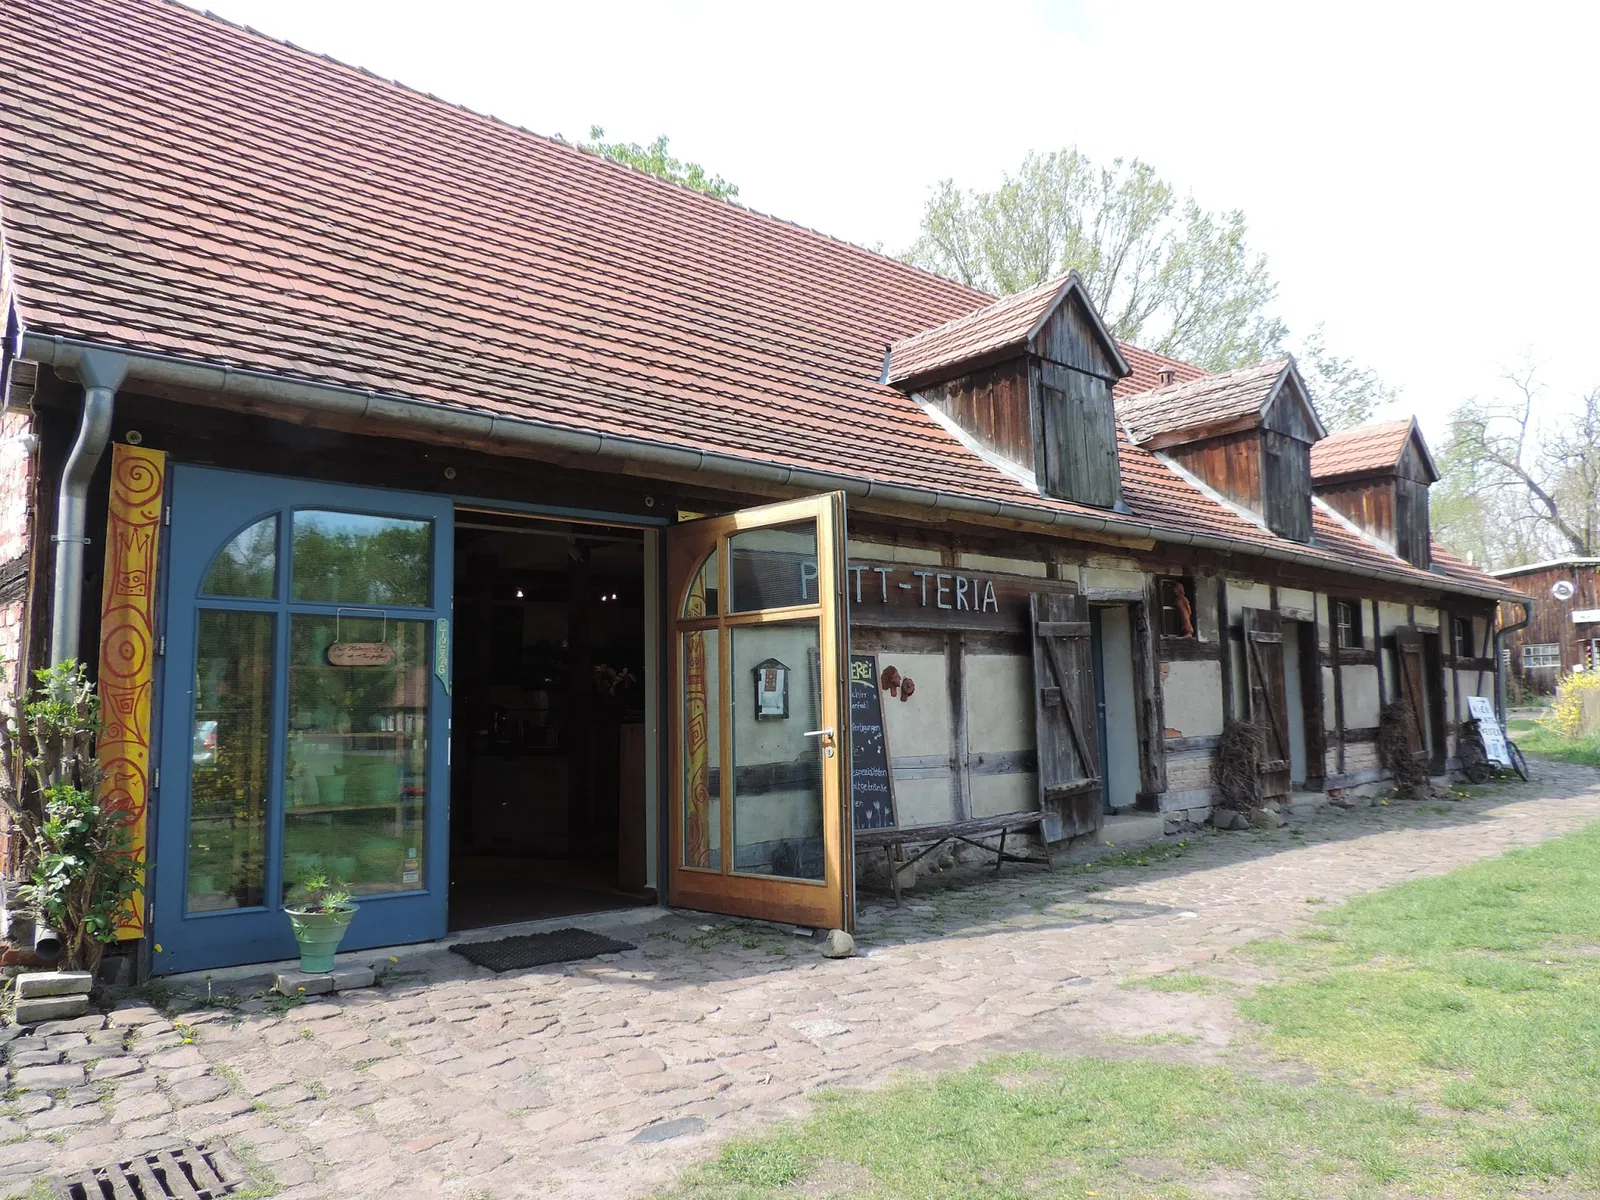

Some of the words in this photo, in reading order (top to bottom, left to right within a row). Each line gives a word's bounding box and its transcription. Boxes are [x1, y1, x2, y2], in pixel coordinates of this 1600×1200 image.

[800, 561, 999, 613] PTT-TERIA
[851, 661, 873, 680] EREi
[851, 688, 868, 698] chirr
